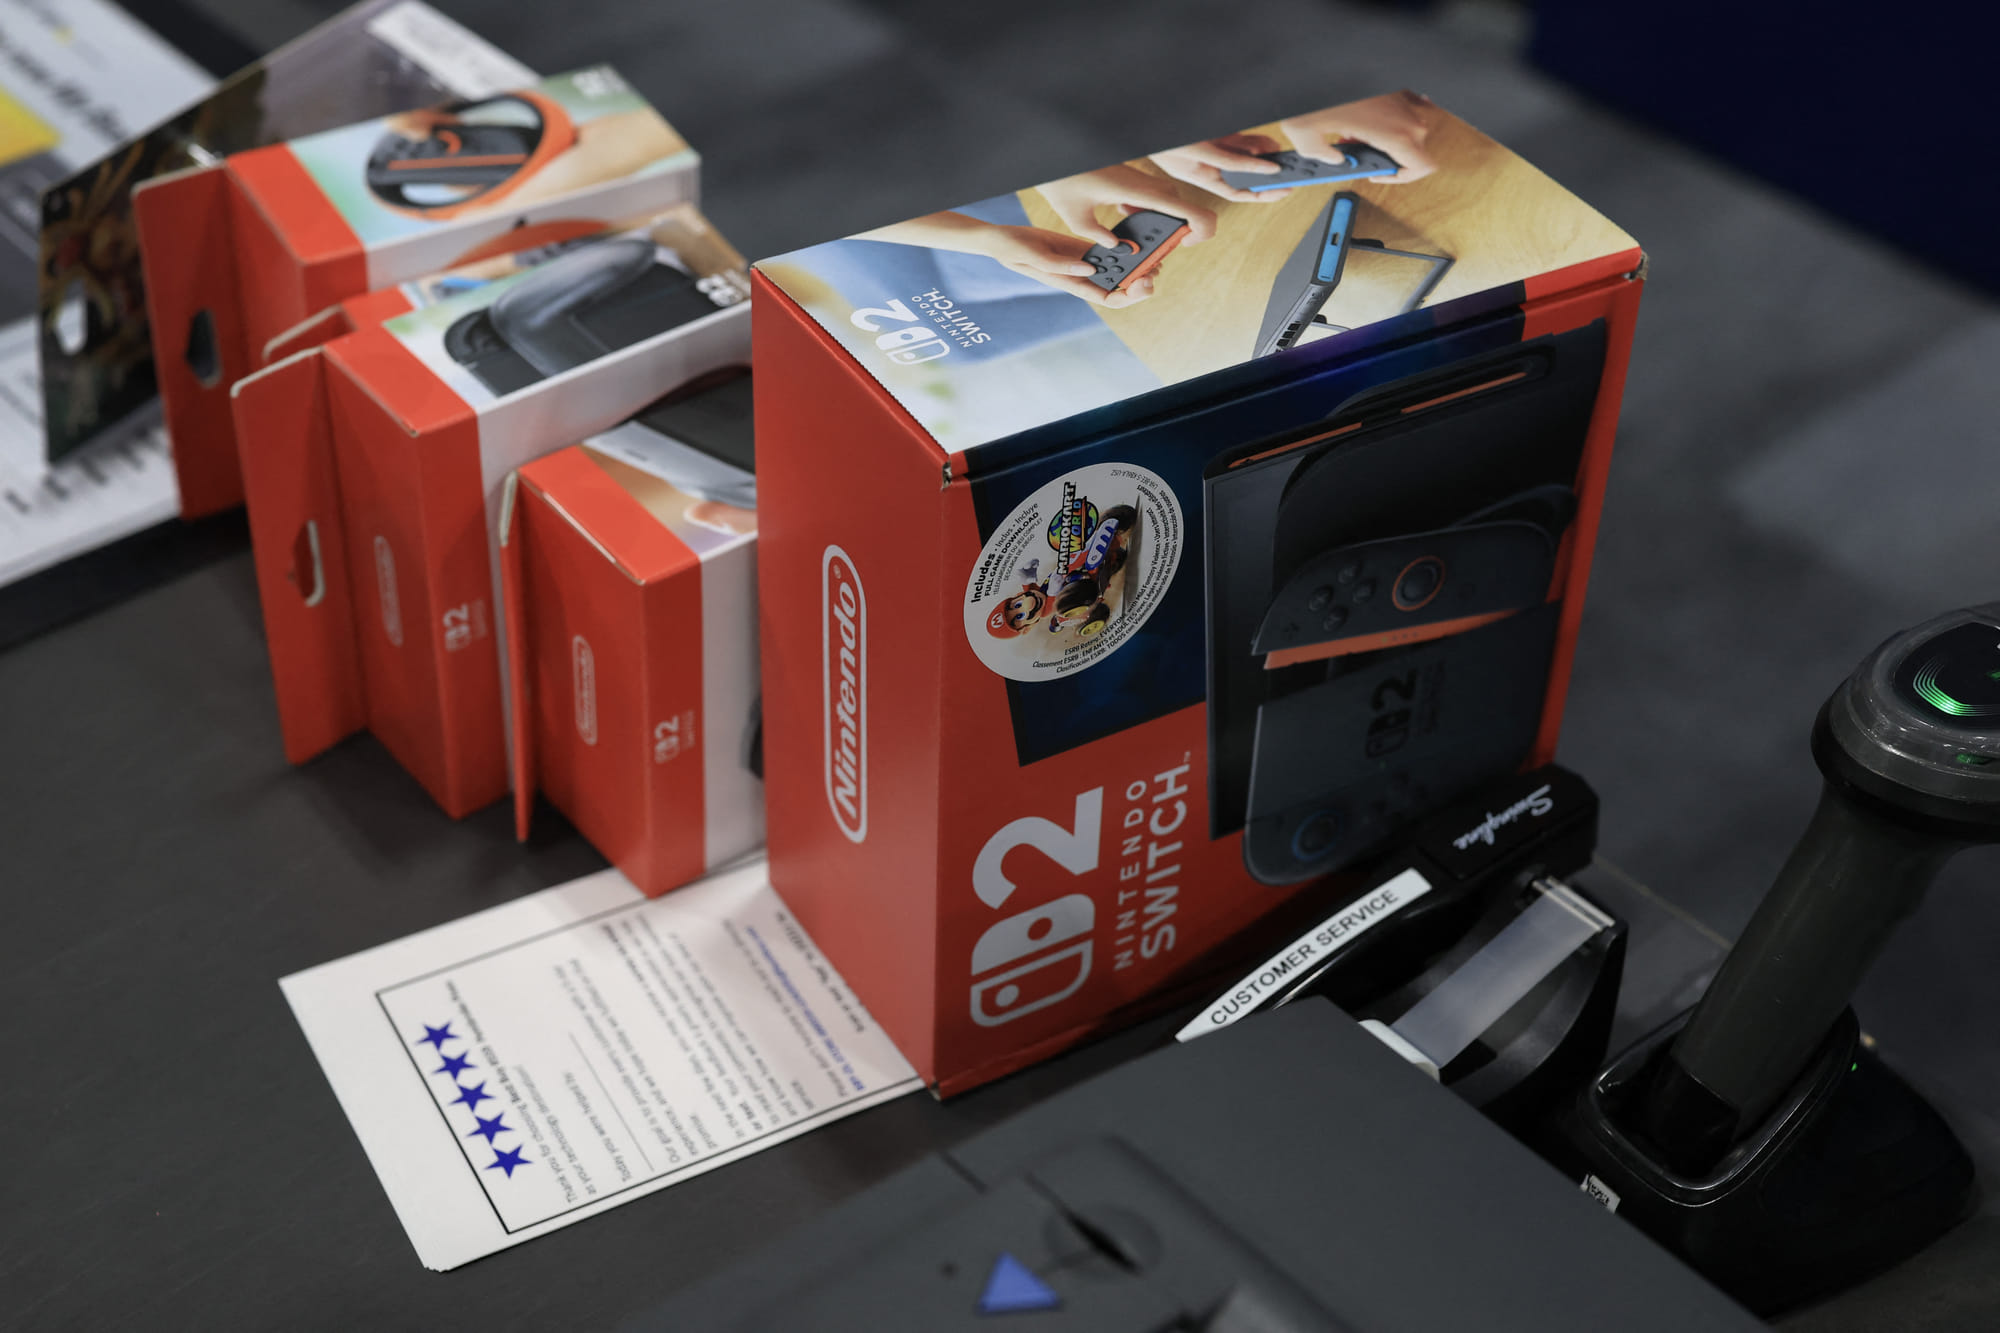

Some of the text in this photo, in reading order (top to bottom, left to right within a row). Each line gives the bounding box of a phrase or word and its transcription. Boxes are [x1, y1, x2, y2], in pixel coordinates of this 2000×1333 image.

[912, 296, 973, 348] NINTENDO
[923, 289, 991, 344] SWITCH
[971, 503, 1039, 603] Includes Inclus Incluye
[984, 512, 1039, 597] FULL GAME DOWNLOAD
[1069, 500, 1082, 552] WORLD
[1033, 658, 1063, 668] Classement
[1082, 638, 1109, 656] ENFANTS
[1115, 610, 1137, 636] ADULTES
[1064, 645, 1079, 655] ESRB
[1107, 633, 1126, 649] TODOS
[833, 582, 857, 819] Nintendo
[1453, 784, 1553, 850] Swingline
[1113, 780, 1147, 972] NINTENDO
[1141, 763, 1191, 958] SWITCH
[1210, 889, 1399, 1026] CUSTOMER SERVICE
[554, 1174, 579, 1202] Thank
[608, 1154, 635, 1182] Today
